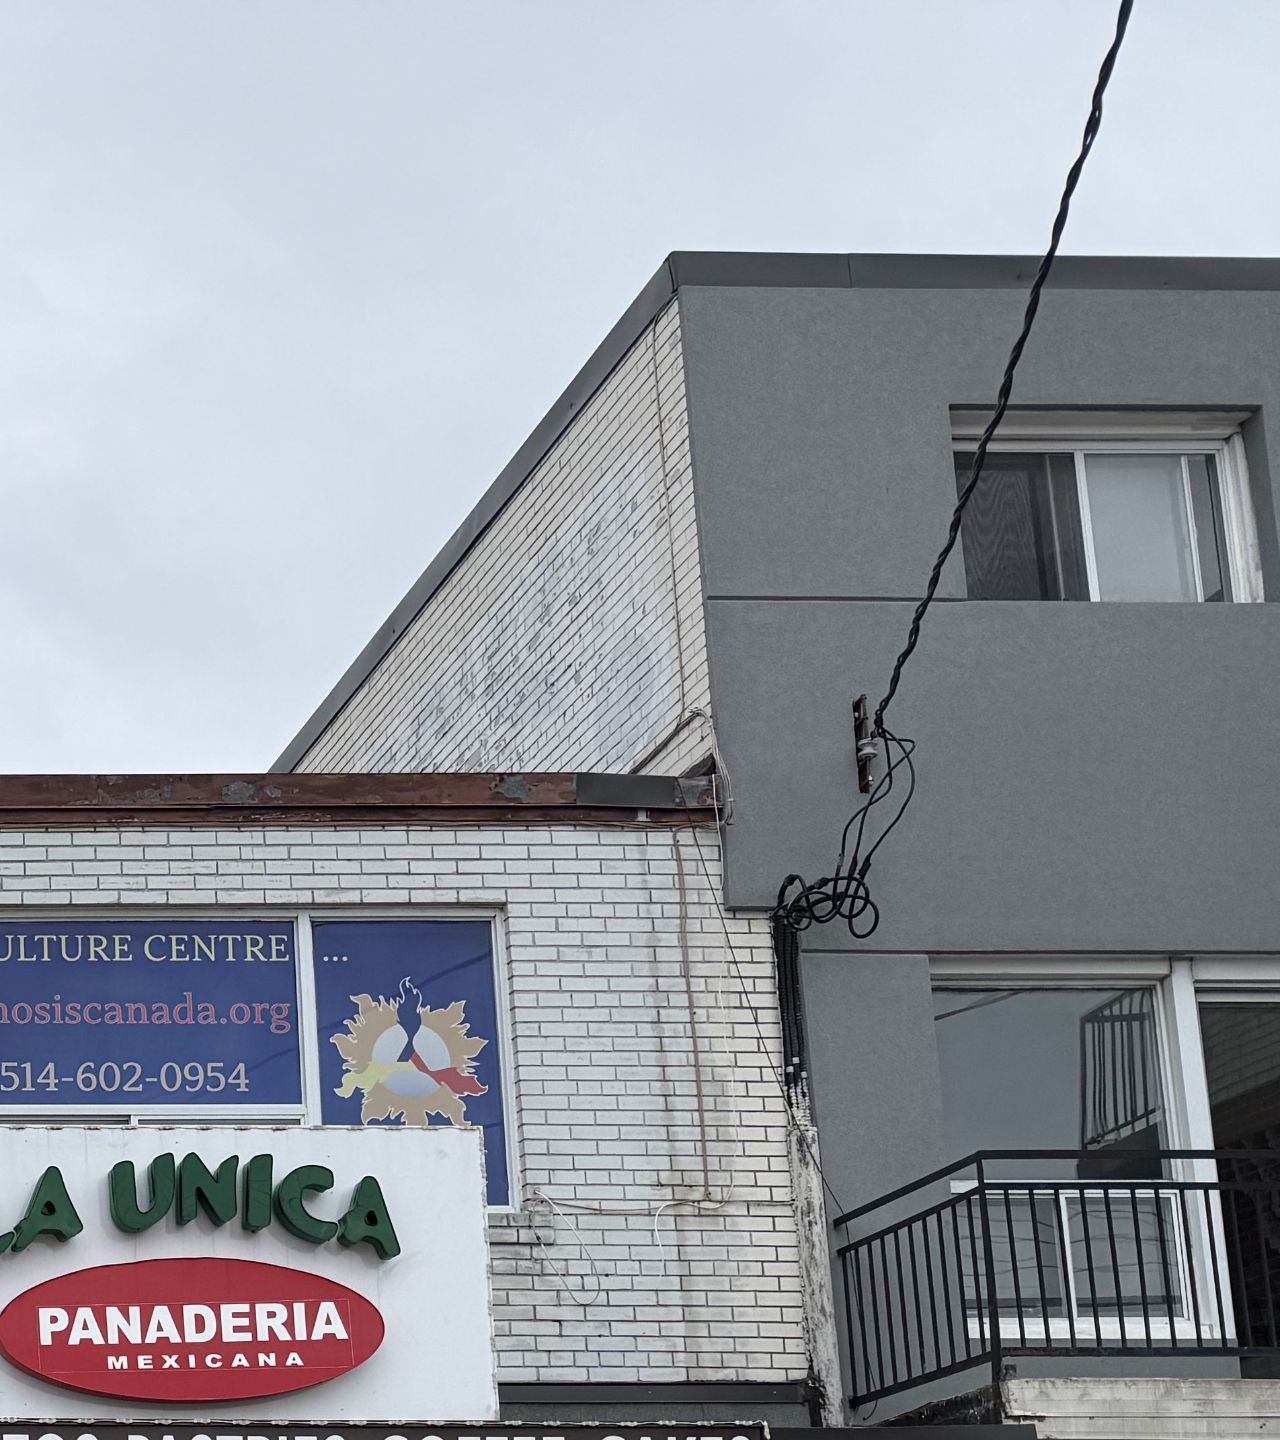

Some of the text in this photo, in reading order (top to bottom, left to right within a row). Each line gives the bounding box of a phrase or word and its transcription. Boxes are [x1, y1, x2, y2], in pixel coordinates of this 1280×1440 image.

[143, 934, 290, 963] CENTRE
[0, 1062, 250, 1093] 514-602-0954
[108, 1151, 401, 1260] UNICA
[38, 1301, 349, 1347] PANADERIA
[107, 1352, 305, 1370] MEXICANA
